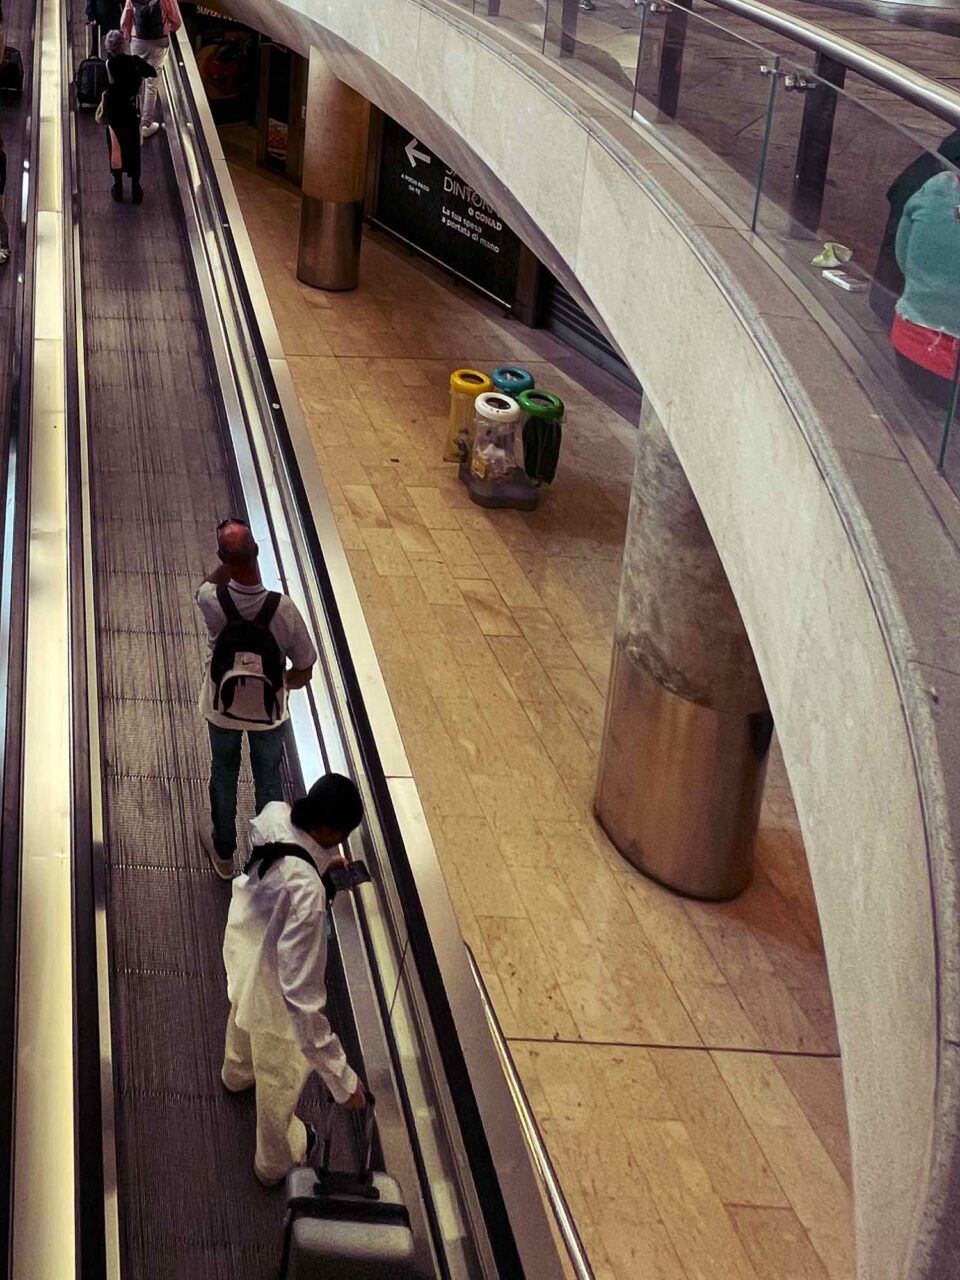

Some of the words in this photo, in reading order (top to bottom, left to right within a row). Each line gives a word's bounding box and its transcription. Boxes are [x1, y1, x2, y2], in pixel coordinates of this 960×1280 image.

[442, 206, 450, 216] La
[451, 211, 462, 222] tua
[463, 218, 482, 233] spesa
[475, 211, 503, 231] CONAD
[446, 219, 470, 237] portata
[471, 233, 478, 241] di
[480, 238, 500, 253] mano
